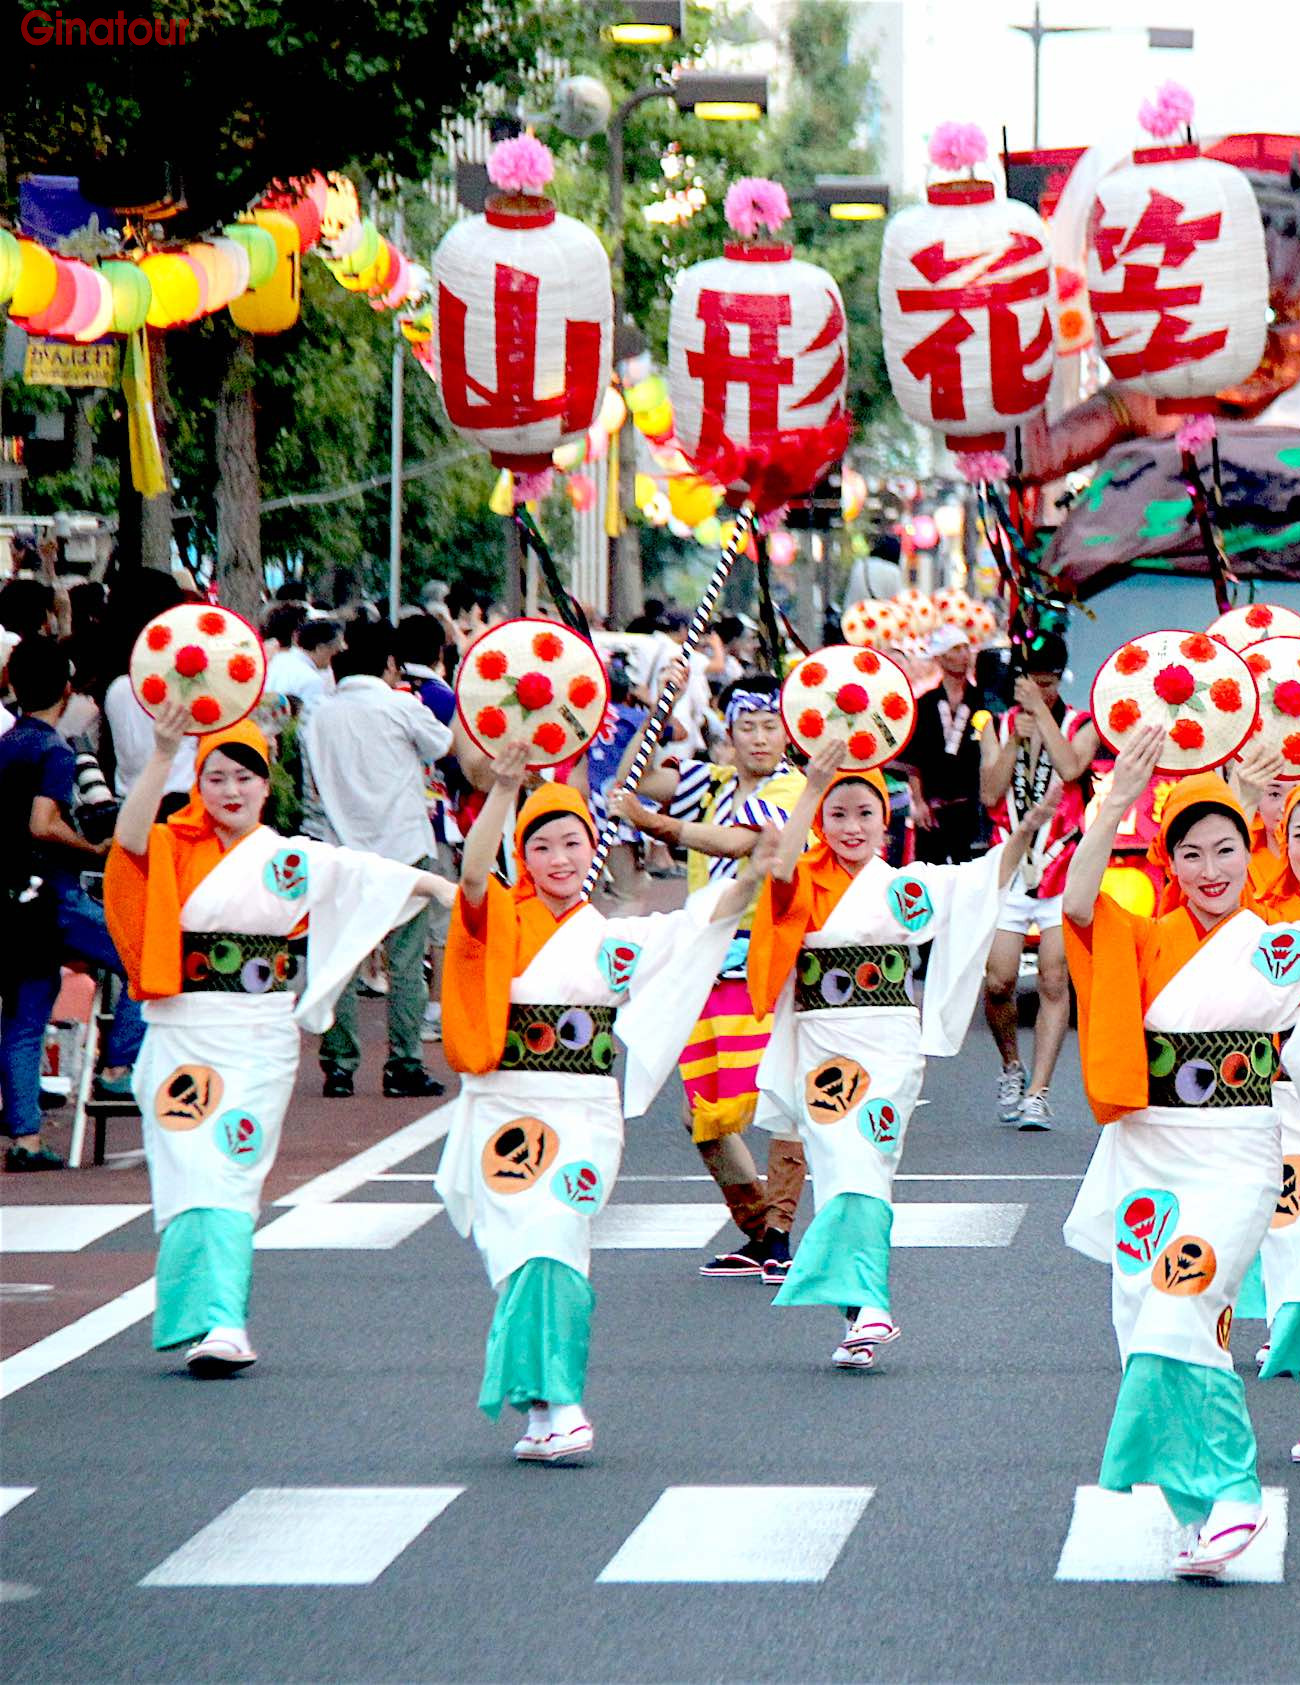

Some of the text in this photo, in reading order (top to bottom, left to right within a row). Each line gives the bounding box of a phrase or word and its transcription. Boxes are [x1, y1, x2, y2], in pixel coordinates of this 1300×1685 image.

[438, 263, 602, 433] 山
[685, 288, 846, 452] 形
[896, 232, 1053, 421] 花
[1089, 188, 1228, 381] 笠
